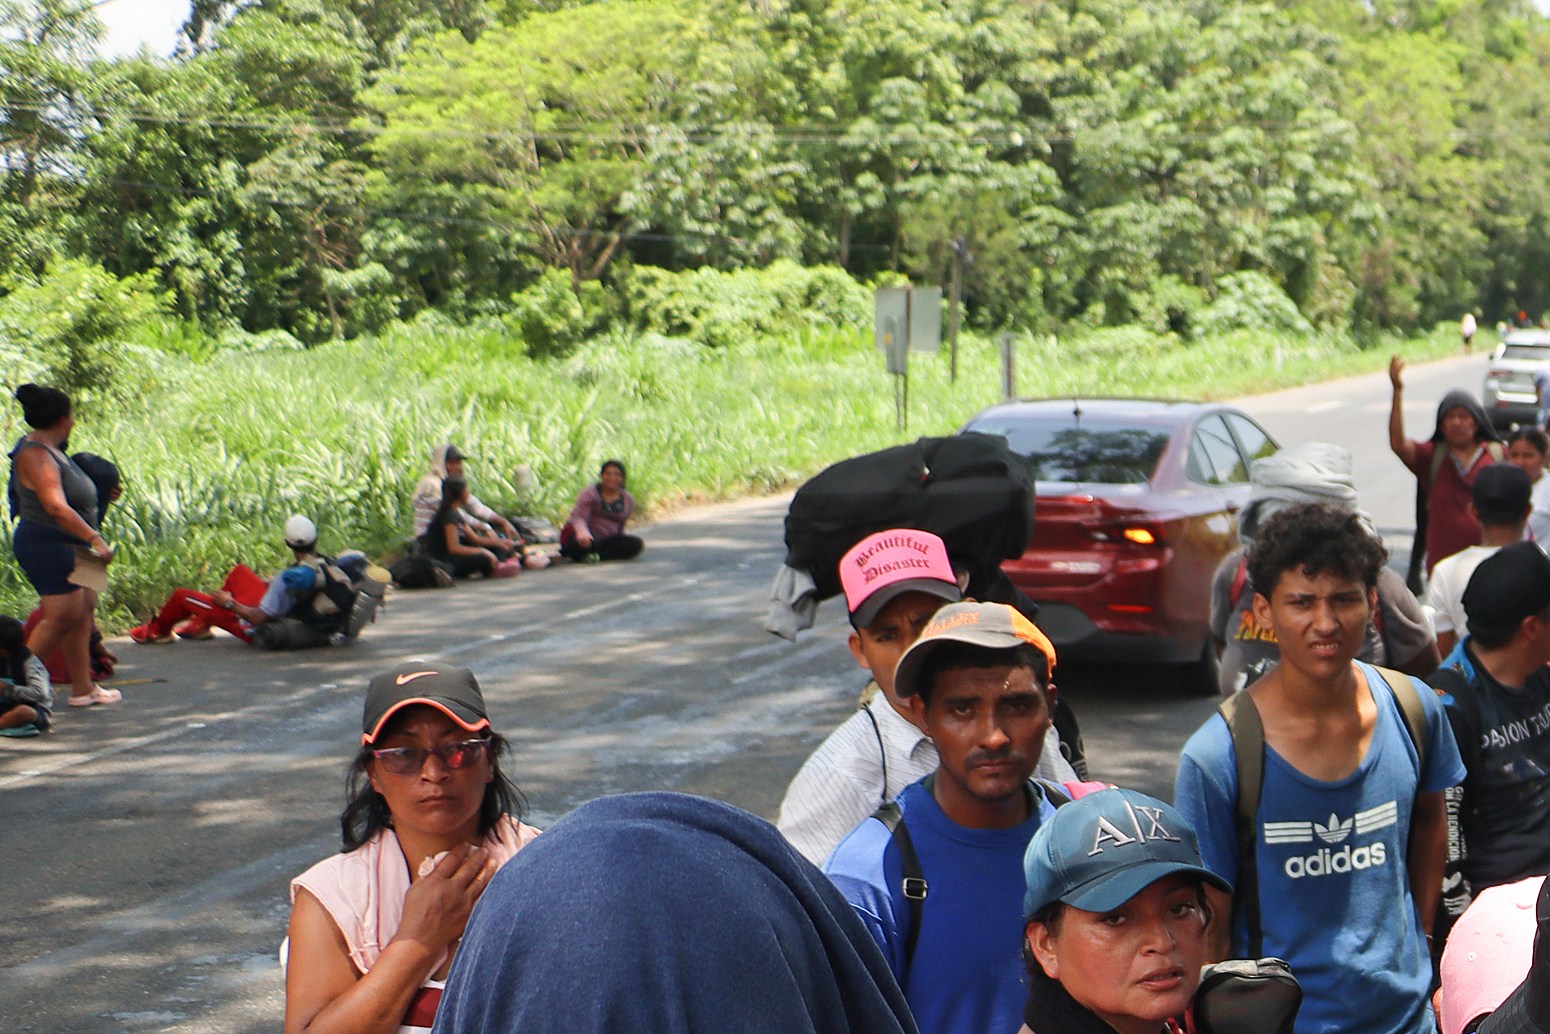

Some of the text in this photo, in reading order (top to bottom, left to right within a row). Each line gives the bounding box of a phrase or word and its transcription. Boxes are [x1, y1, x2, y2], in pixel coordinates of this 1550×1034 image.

[854, 535, 929, 568] Beautiful
[861, 558, 930, 584] Disaster
[1285, 842, 1386, 879] adidas
